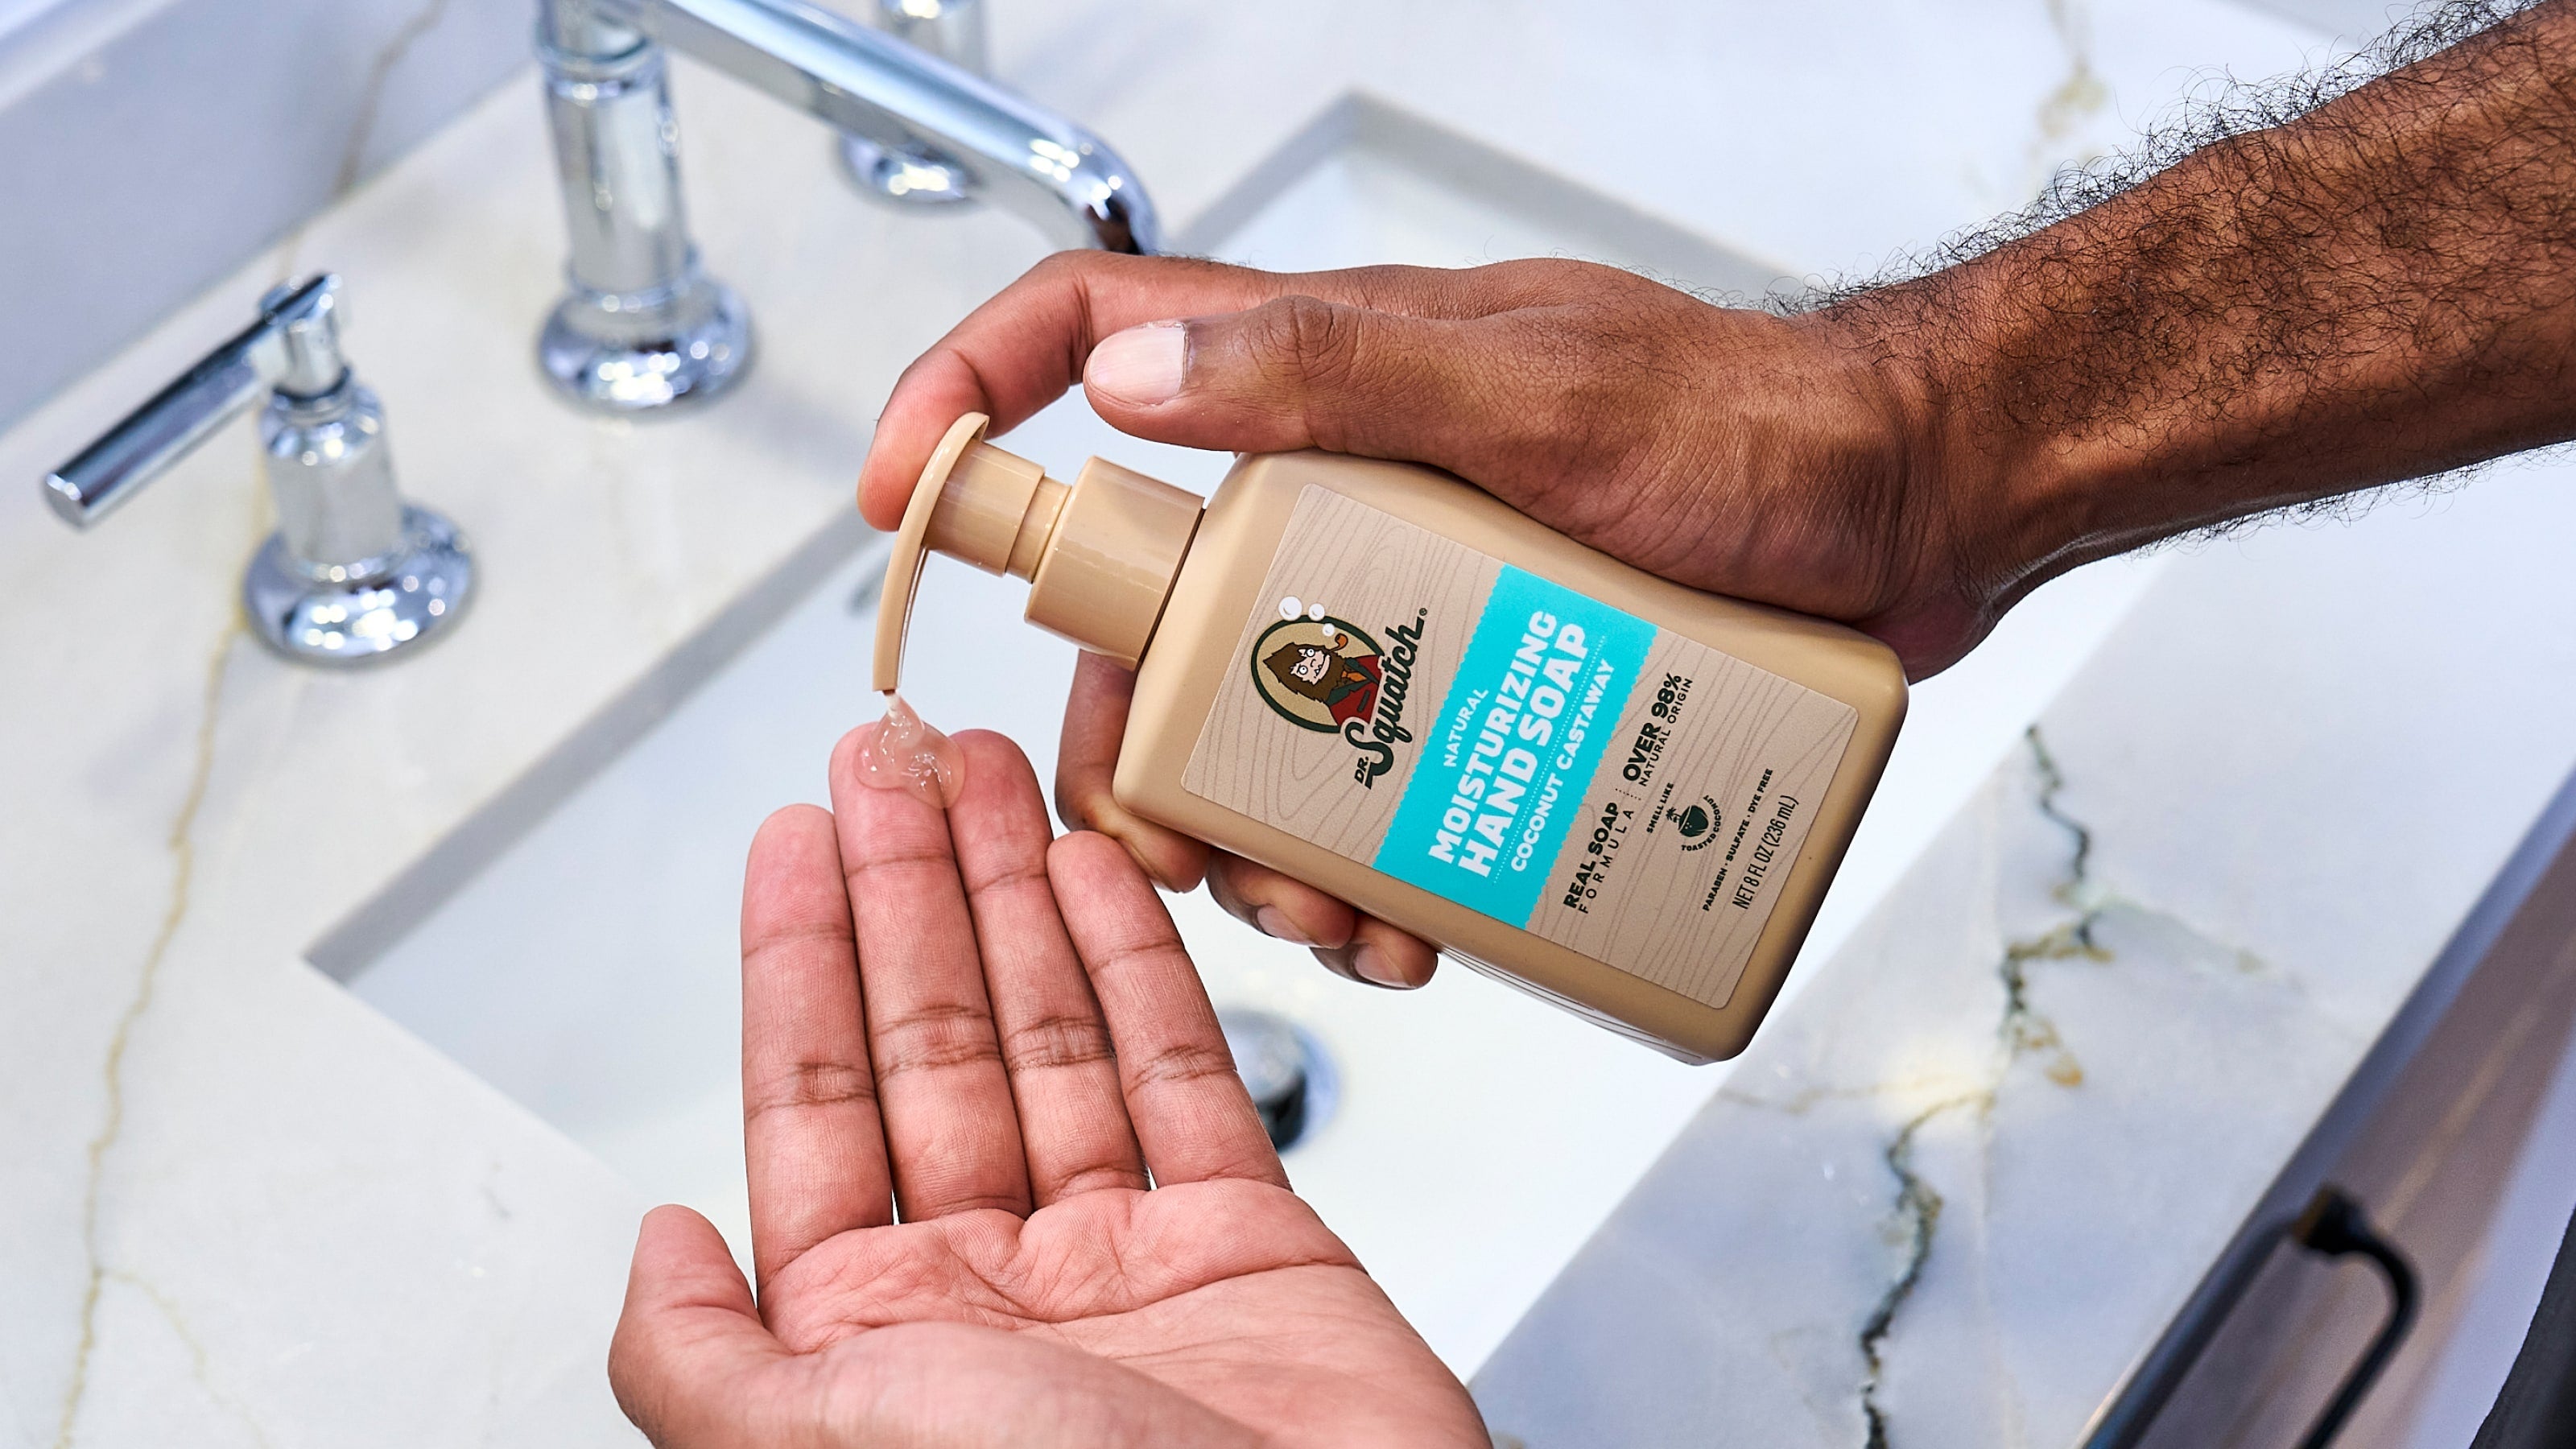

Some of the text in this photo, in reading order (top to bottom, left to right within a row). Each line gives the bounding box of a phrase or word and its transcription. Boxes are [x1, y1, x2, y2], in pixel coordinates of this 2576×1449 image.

[1354, 757, 1369, 783] DR.
[1428, 610, 1557, 864] MOISTURIZING
[1443, 688, 1488, 768] NATURAL
[1458, 623, 1588, 877] HAND SOAP
[1511, 658, 1615, 872] COCONUT CASTAWAY
[1623, 672, 1682, 782] OVER 98%
[1638, 678, 1693, 786] NATURAL ORIGIN
[1563, 802, 1619, 909] REAL SOAP
[1646, 782, 1674, 833] SMELL LIKE
[1681, 795, 1722, 852] TOASTED COCONUT
[1702, 768, 1773, 911] PARABEN SULFATE DYE FREE
[1732, 795, 1799, 910] NET 8 FL OZ (236 mL)
[1579, 810, 1634, 914] FORMULA
